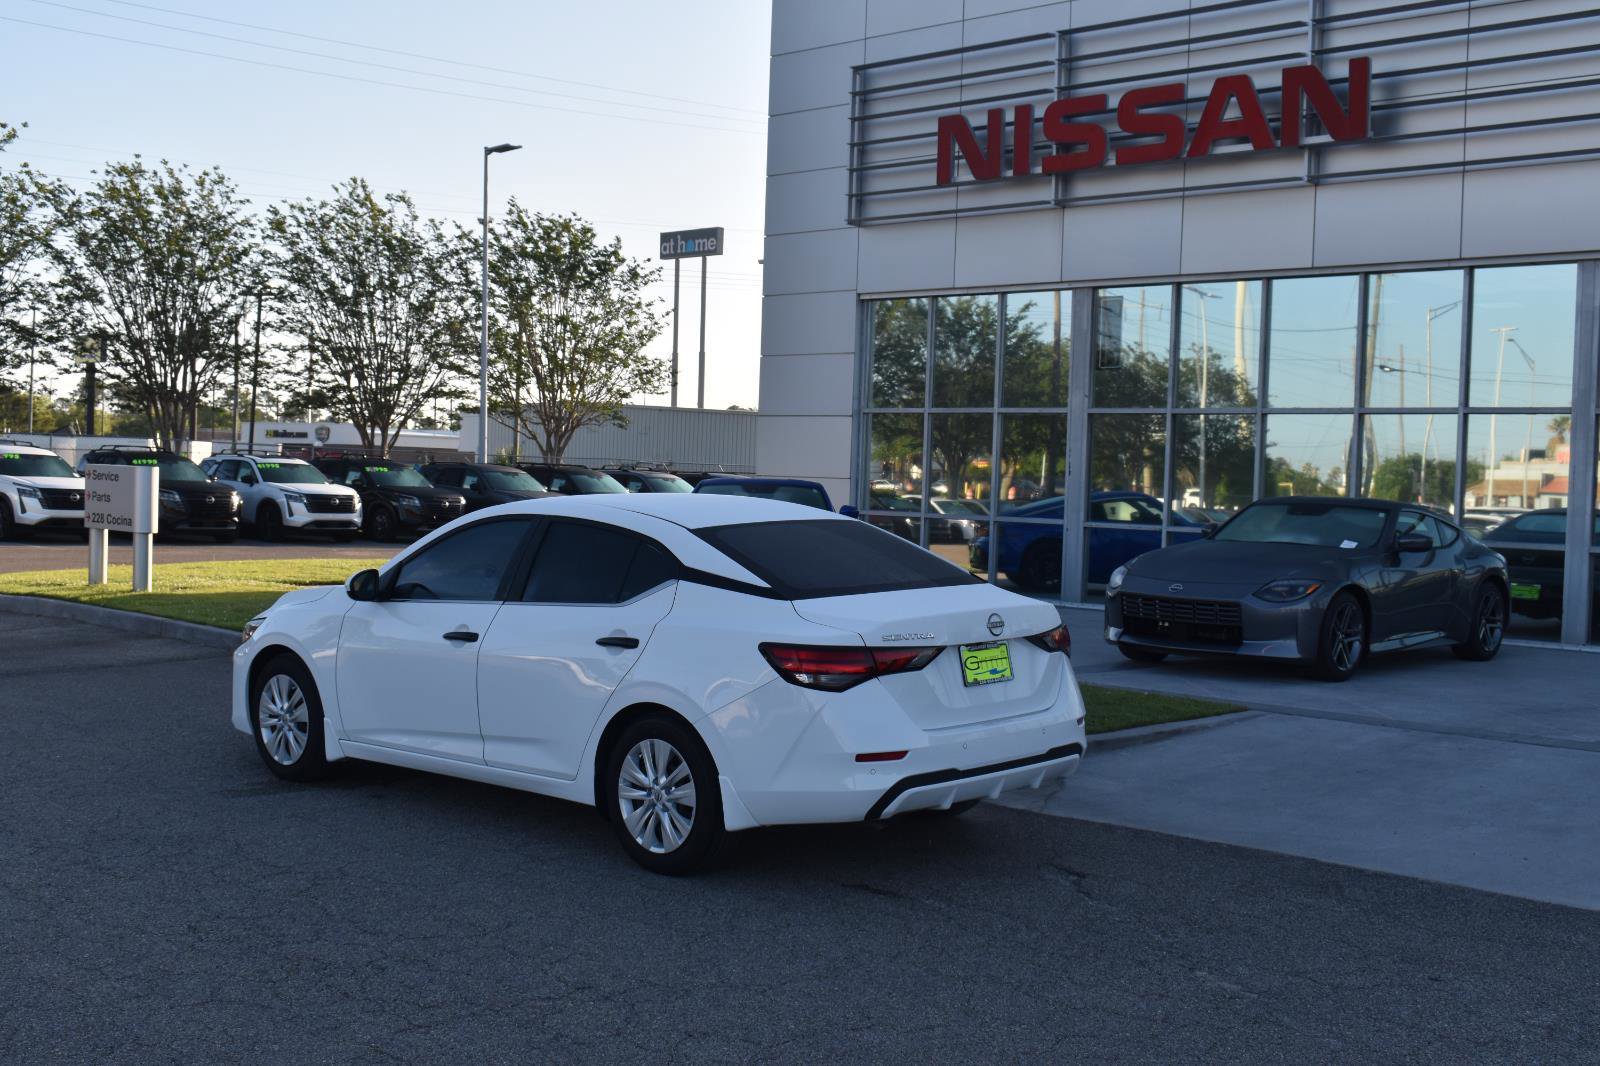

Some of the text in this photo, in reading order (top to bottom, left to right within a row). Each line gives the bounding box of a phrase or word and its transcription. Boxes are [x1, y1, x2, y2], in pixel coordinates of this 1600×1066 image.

[936, 56, 1372, 186] NISSAN
[661, 238, 674, 255] at
[92, 469, 119, 482] Service
[92, 490, 111, 503] Parts
[92, 512, 132, 527] 228 Cocina
[882, 632, 935, 641] SENTRA
